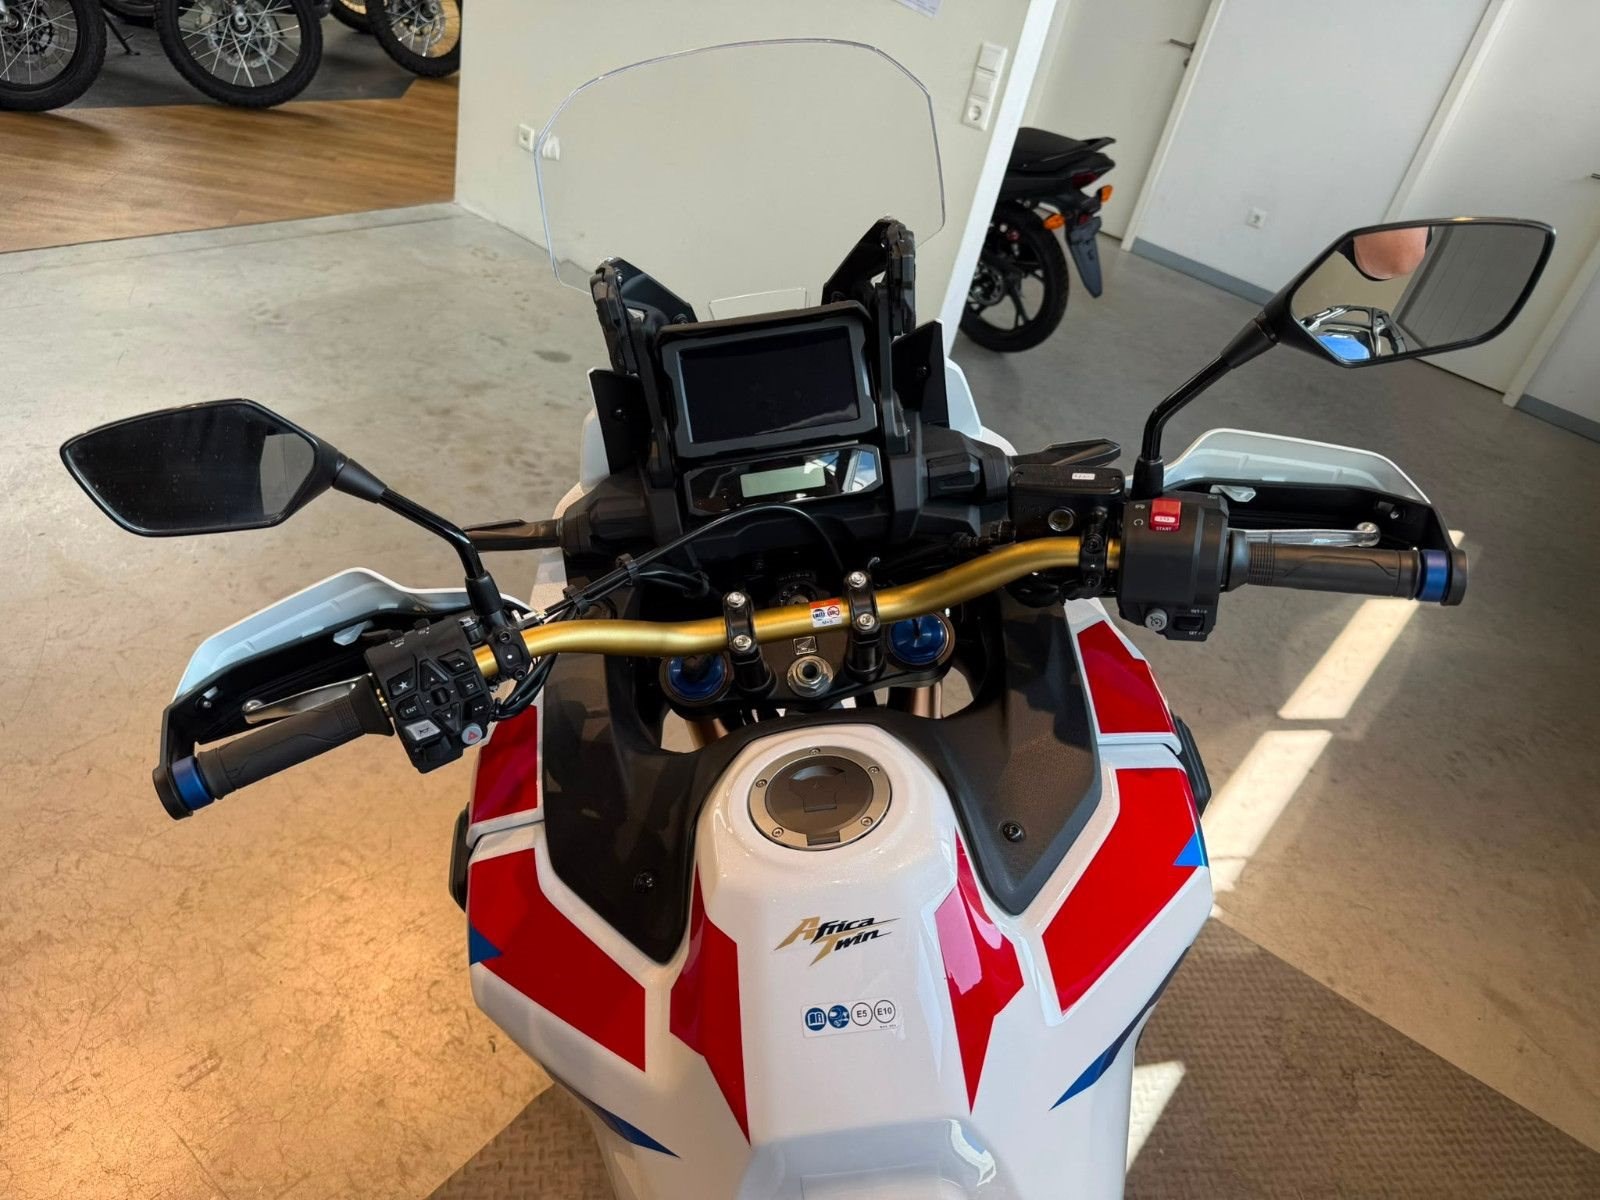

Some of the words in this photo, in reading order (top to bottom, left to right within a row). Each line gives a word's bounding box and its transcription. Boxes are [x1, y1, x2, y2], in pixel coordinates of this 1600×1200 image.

[406, 705, 417, 714] ENT
[774, 916, 901, 951] Africa
[809, 928, 892, 967] Twin
[857, 1010, 868, 1018] E5
[877, 1007, 892, 1015] E10
